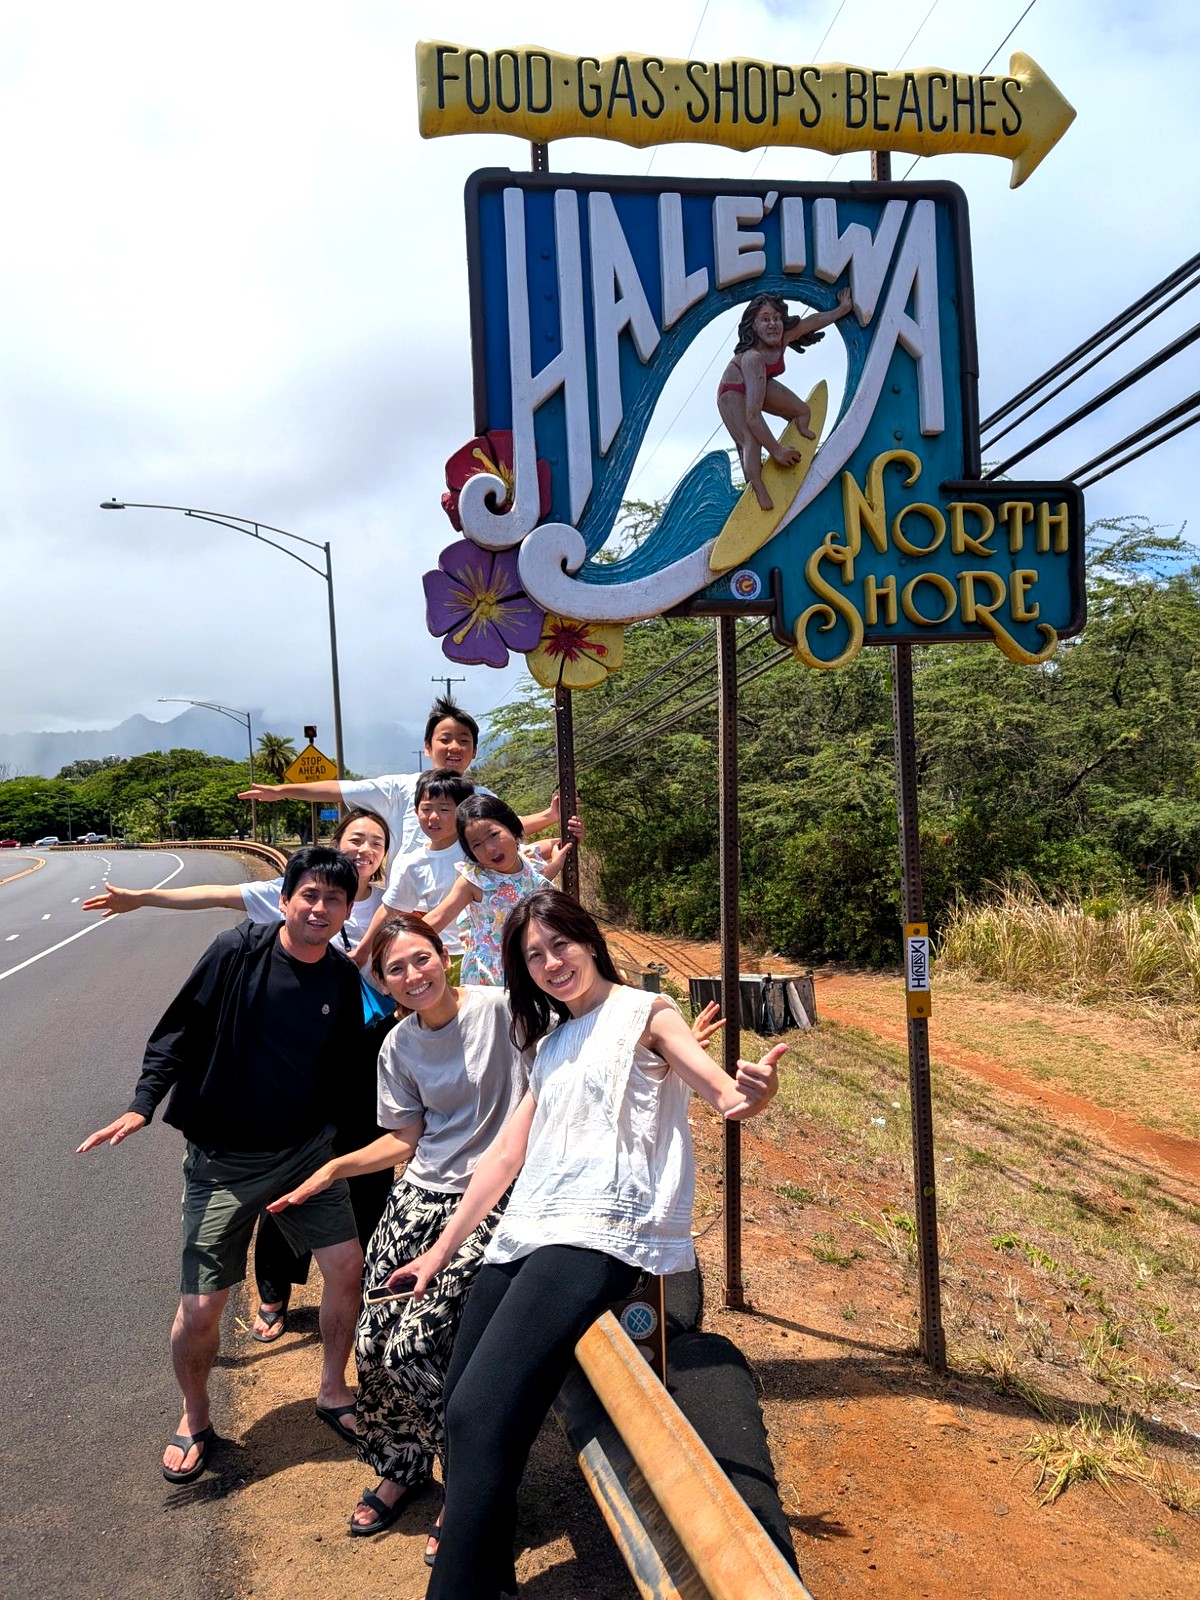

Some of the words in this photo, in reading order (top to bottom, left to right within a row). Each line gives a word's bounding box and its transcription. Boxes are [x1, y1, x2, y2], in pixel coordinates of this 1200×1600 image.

[435, 47, 552, 114] FOOD
[577, 56, 669, 120] GAS
[685, 61, 823, 129] SHOPS
[845, 70, 1024, 137] BEACHES
[841, 449, 1069, 558] NORTH
[794, 532, 1058, 669] SHORE
[299, 766, 326, 775] AHEAD
[301, 757, 322, 766] STOP
